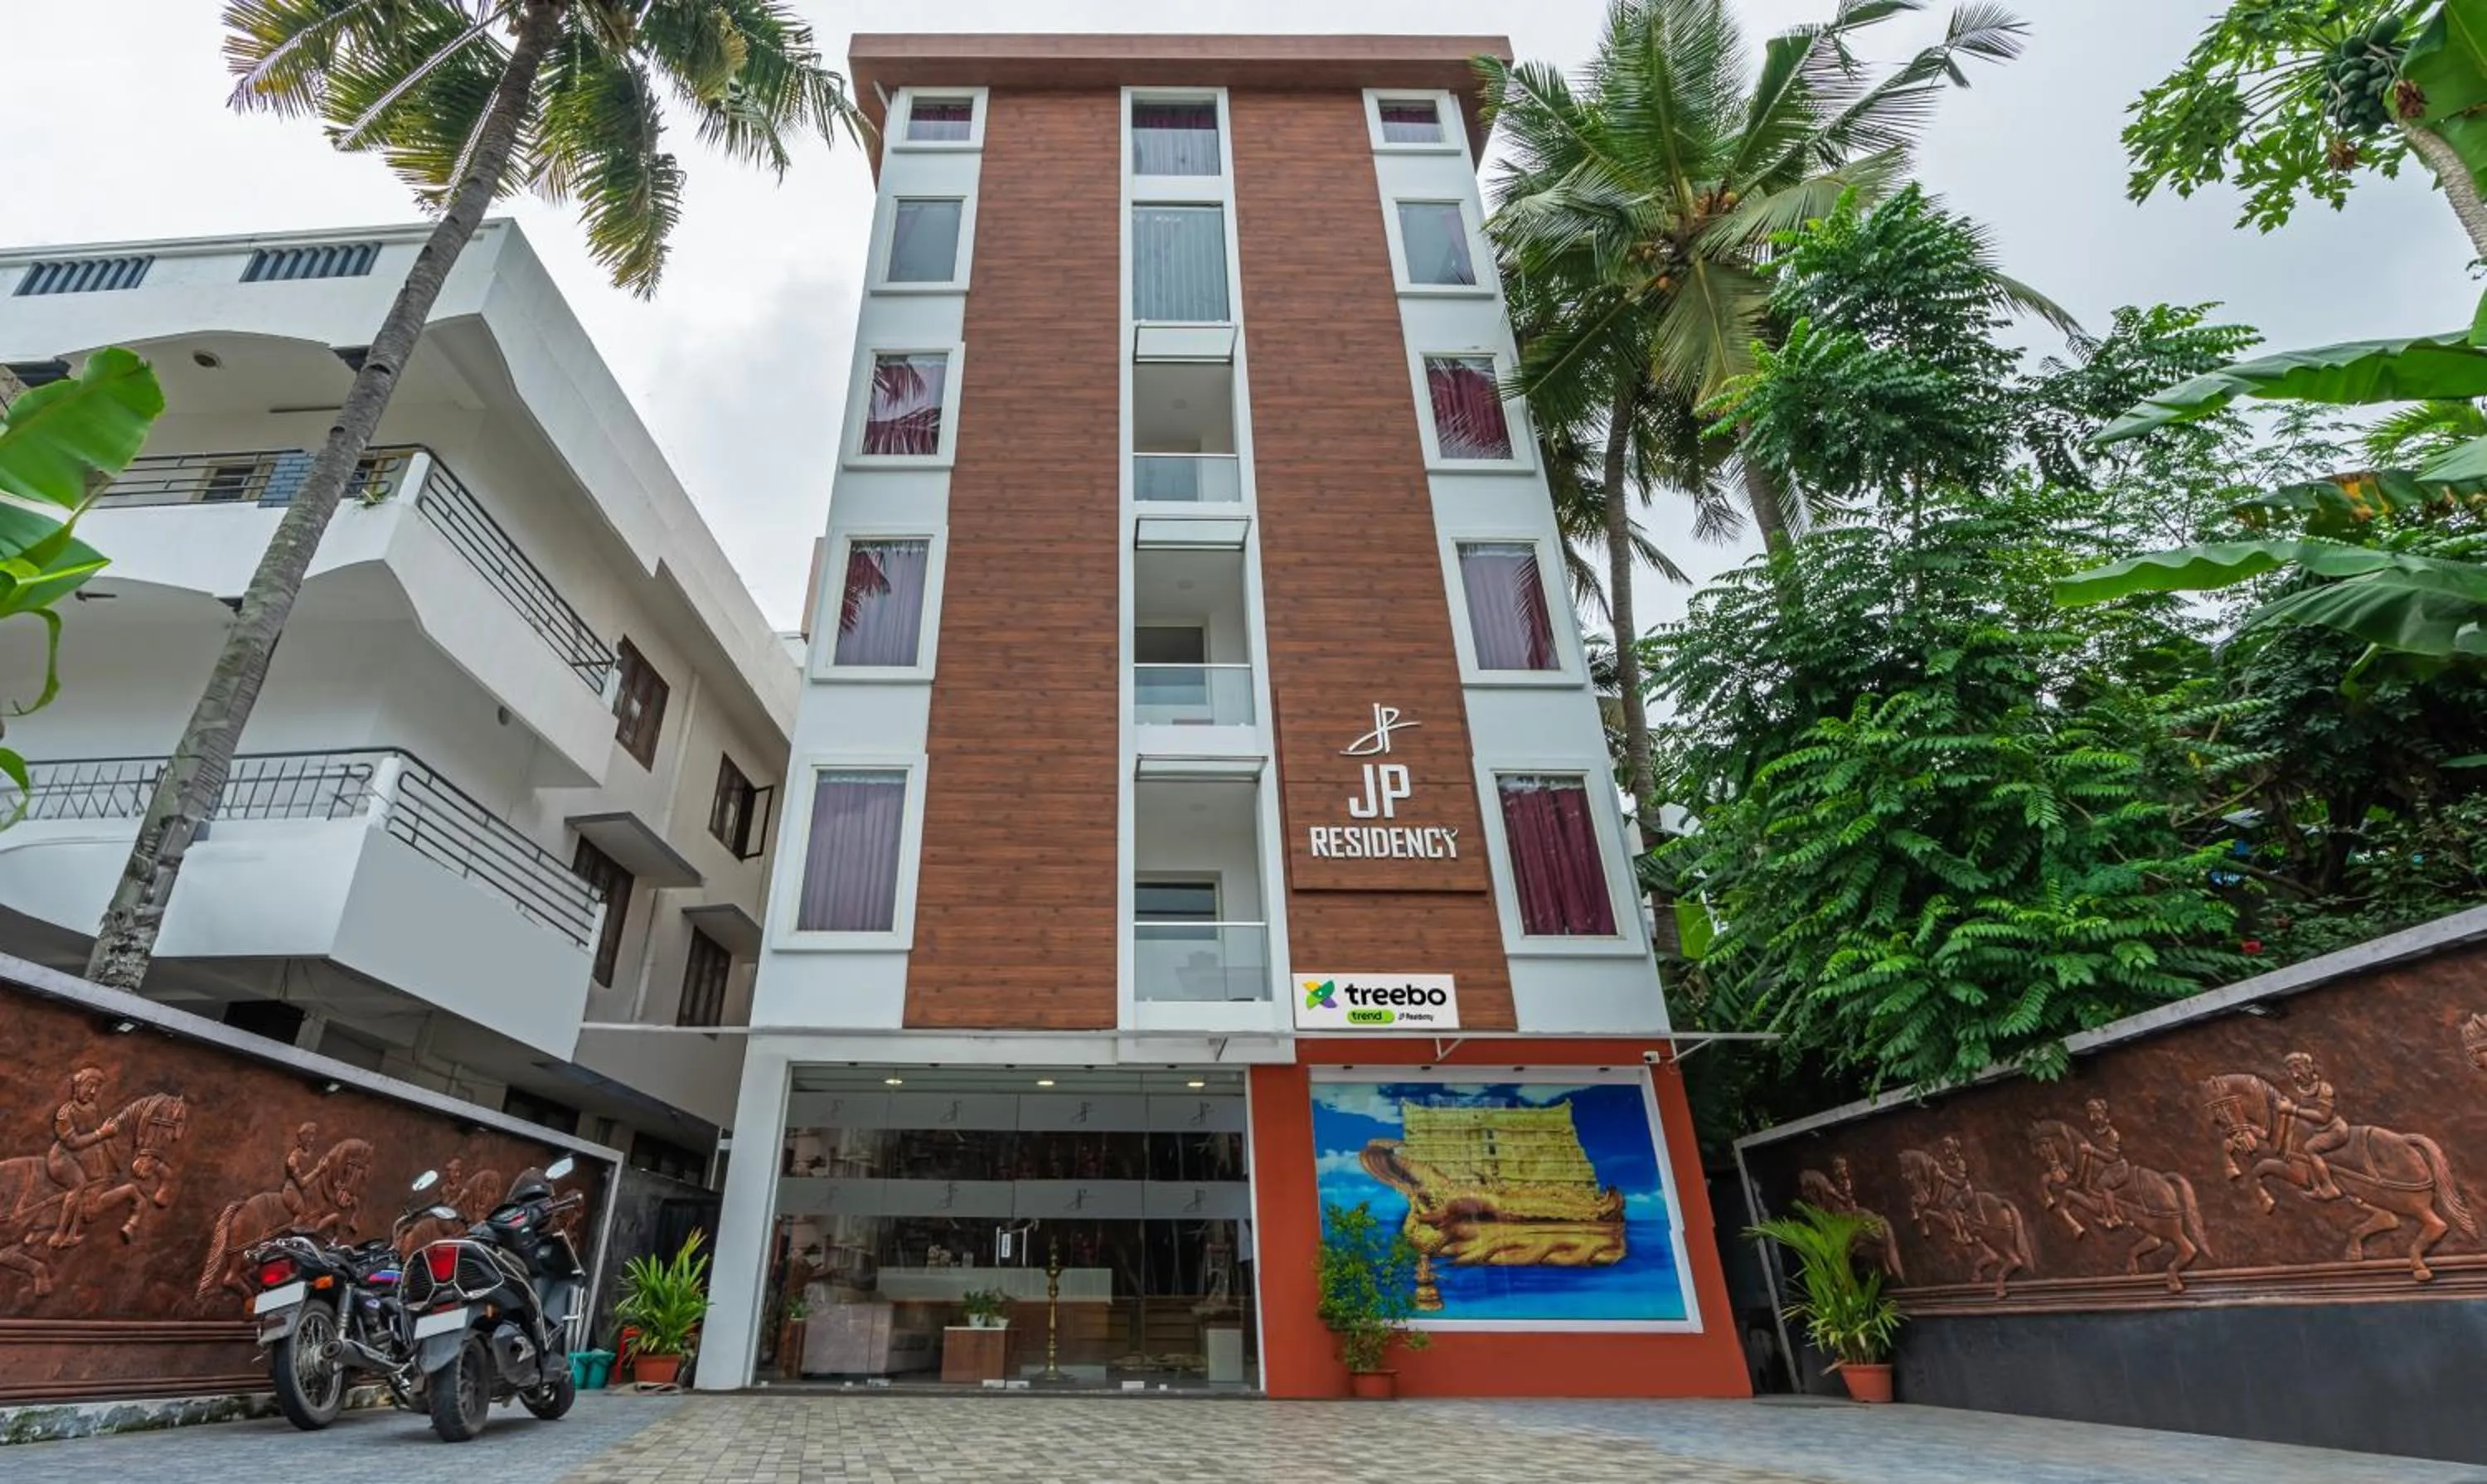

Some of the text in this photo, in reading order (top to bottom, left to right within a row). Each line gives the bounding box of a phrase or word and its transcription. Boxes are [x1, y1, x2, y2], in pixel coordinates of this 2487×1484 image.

[1349, 764, 1411, 818] JP
[1310, 827, 1458, 859] RESIDENCY
[1345, 983, 1447, 1006] treebo
[1352, 1011, 1382, 1021] trend
